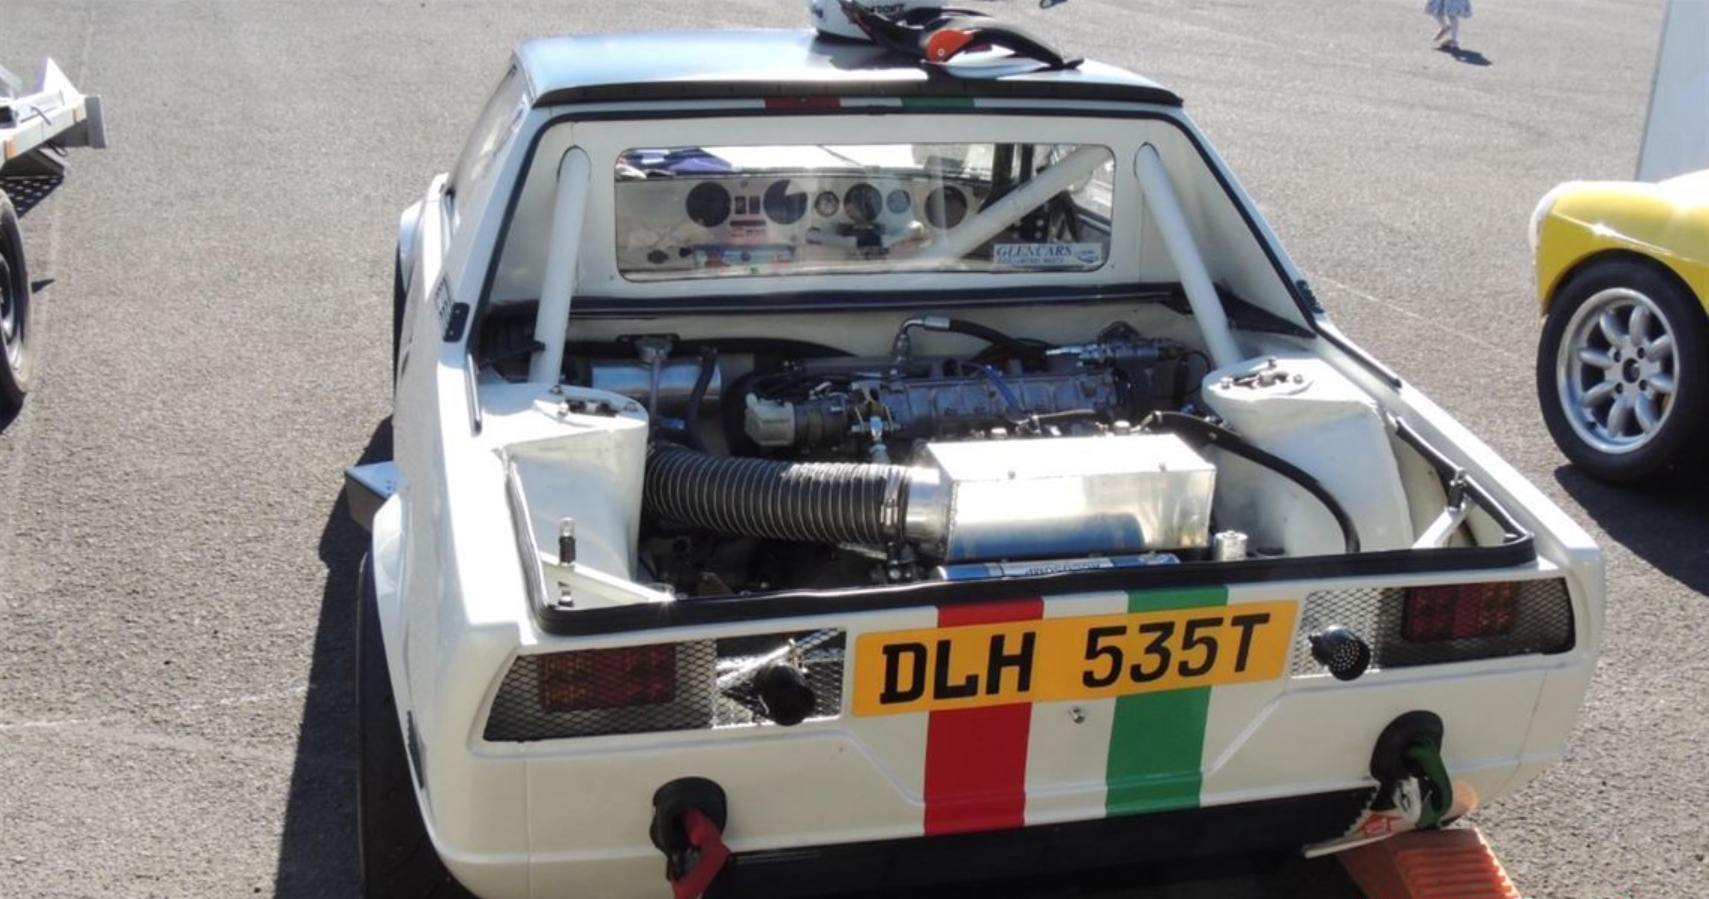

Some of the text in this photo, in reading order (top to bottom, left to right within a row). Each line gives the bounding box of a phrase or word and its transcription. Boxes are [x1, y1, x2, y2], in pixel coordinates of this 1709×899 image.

[996, 244, 1072, 257] GLENCARS
[879, 612, 1271, 705] DLH 535T
